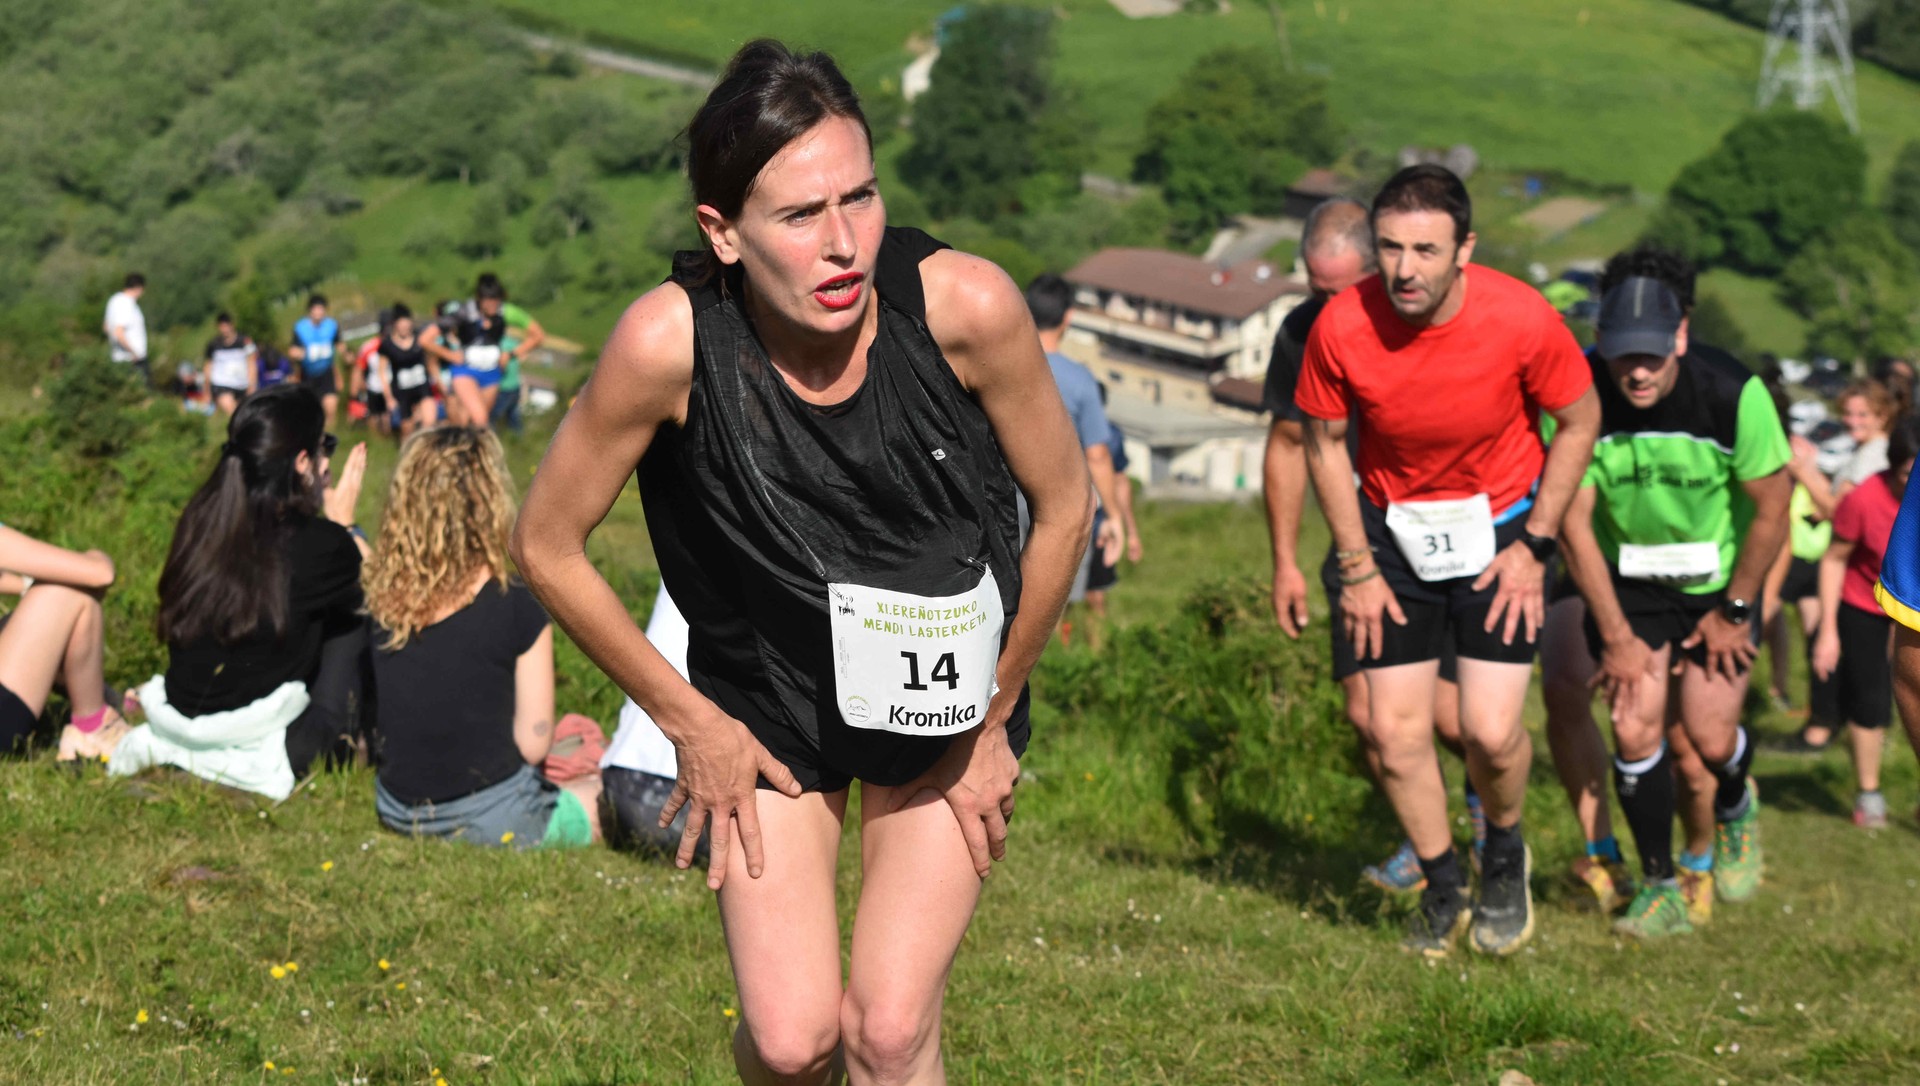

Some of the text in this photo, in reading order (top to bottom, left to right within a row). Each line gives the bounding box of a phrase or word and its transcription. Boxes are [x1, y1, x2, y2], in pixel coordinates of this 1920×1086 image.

[1423, 533, 1455, 556] 31
[877, 601, 978, 621] XI.EREÑOTZUKO
[864, 612, 987, 639] MENDI LASTERKETA
[901, 651, 960, 691] 14
[889, 704, 976, 727] Kronika
